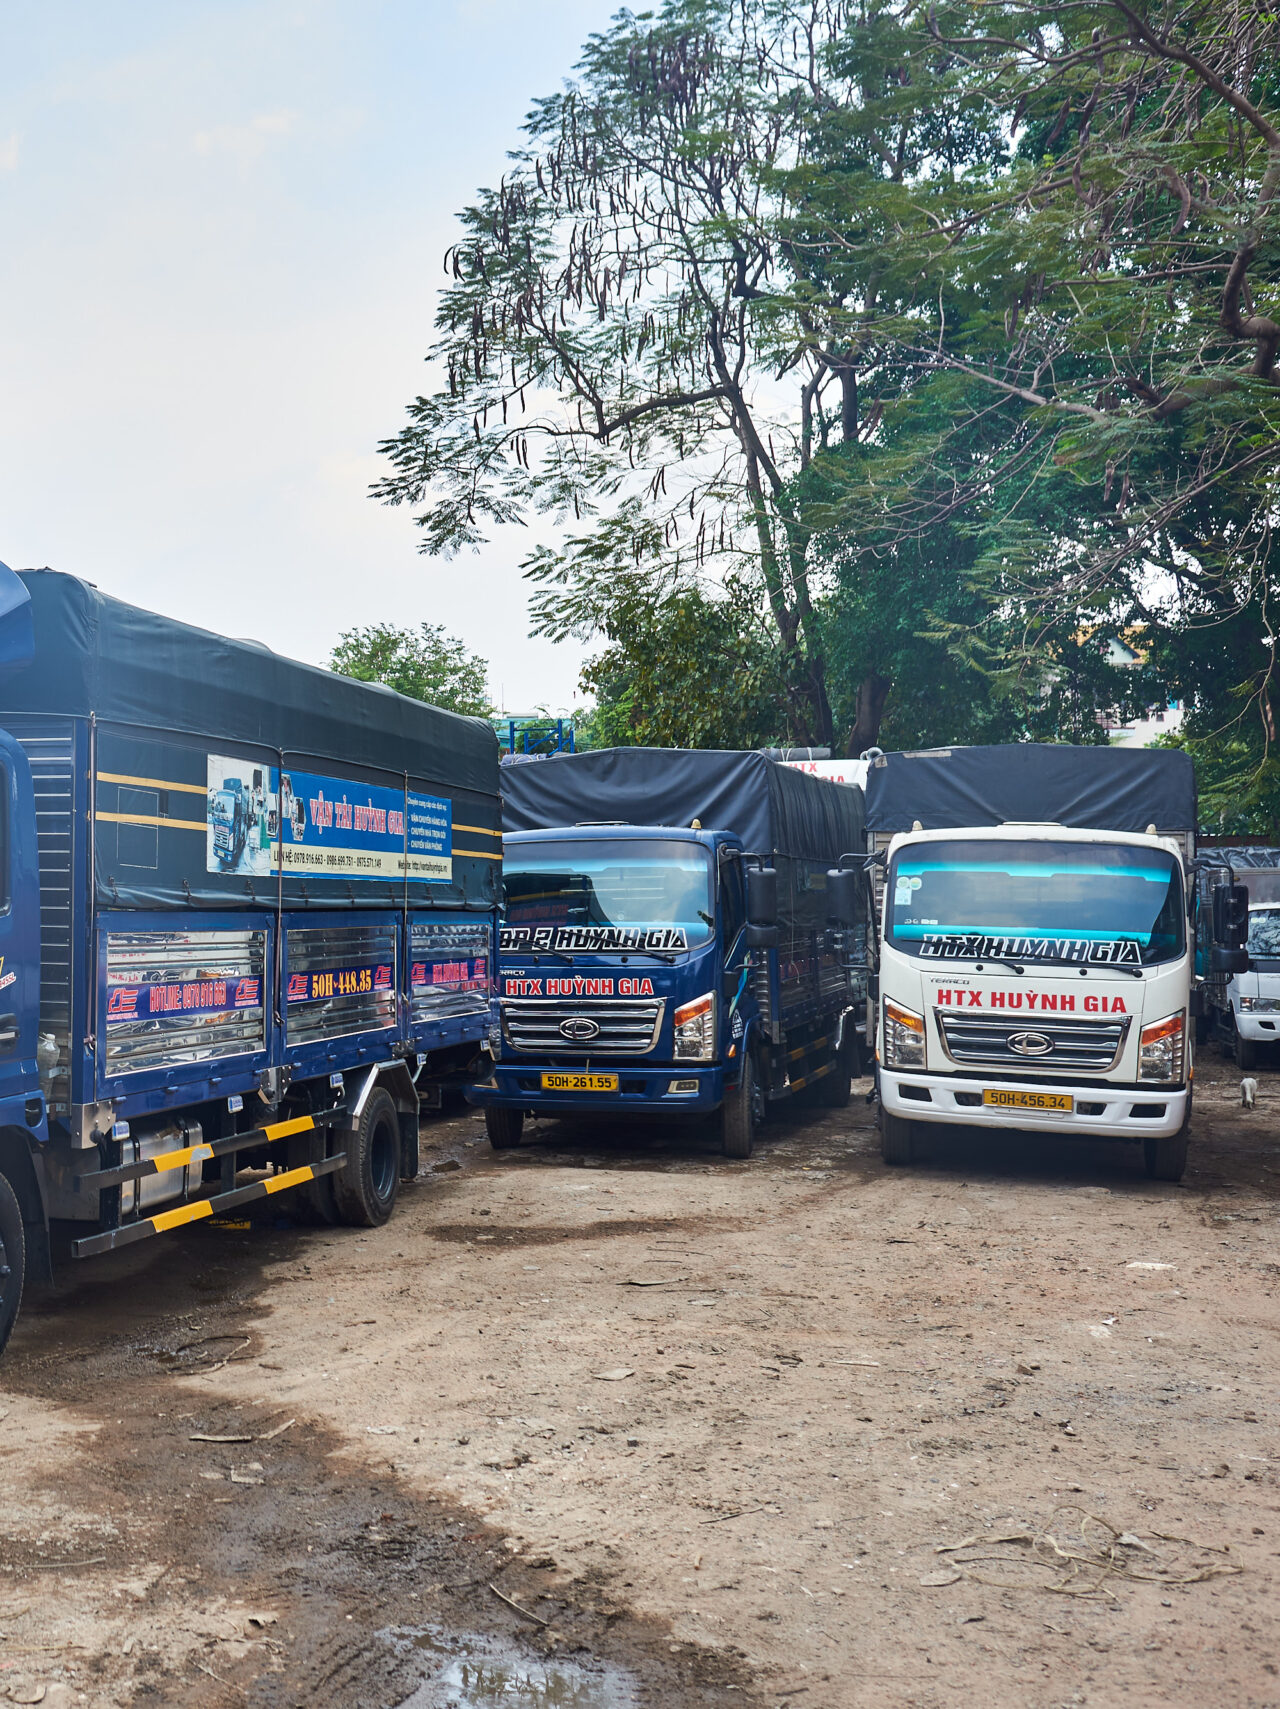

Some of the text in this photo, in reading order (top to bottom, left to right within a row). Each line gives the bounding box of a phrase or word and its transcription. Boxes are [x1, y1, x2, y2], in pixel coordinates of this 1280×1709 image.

[309, 789, 333, 834] VẬN
[335, 794, 352, 830] TẢI
[387, 809, 405, 836] GIA
[273, 850, 285, 862] LIN
[311, 969, 372, 999] 50H-448.35
[505, 979, 542, 995] HTX
[546, 975, 615, 995] HUỲNH
[618, 978, 654, 996] GIA
[150, 984, 182, 1013] HOTLINE:
[182, 983, 200, 1010] 0978
[937, 989, 1127, 1013] HTX HUỲNH GIA
[547, 1076, 612, 1088] 50H-261.55
[990, 1092, 1066, 1109] 50H-456.34
